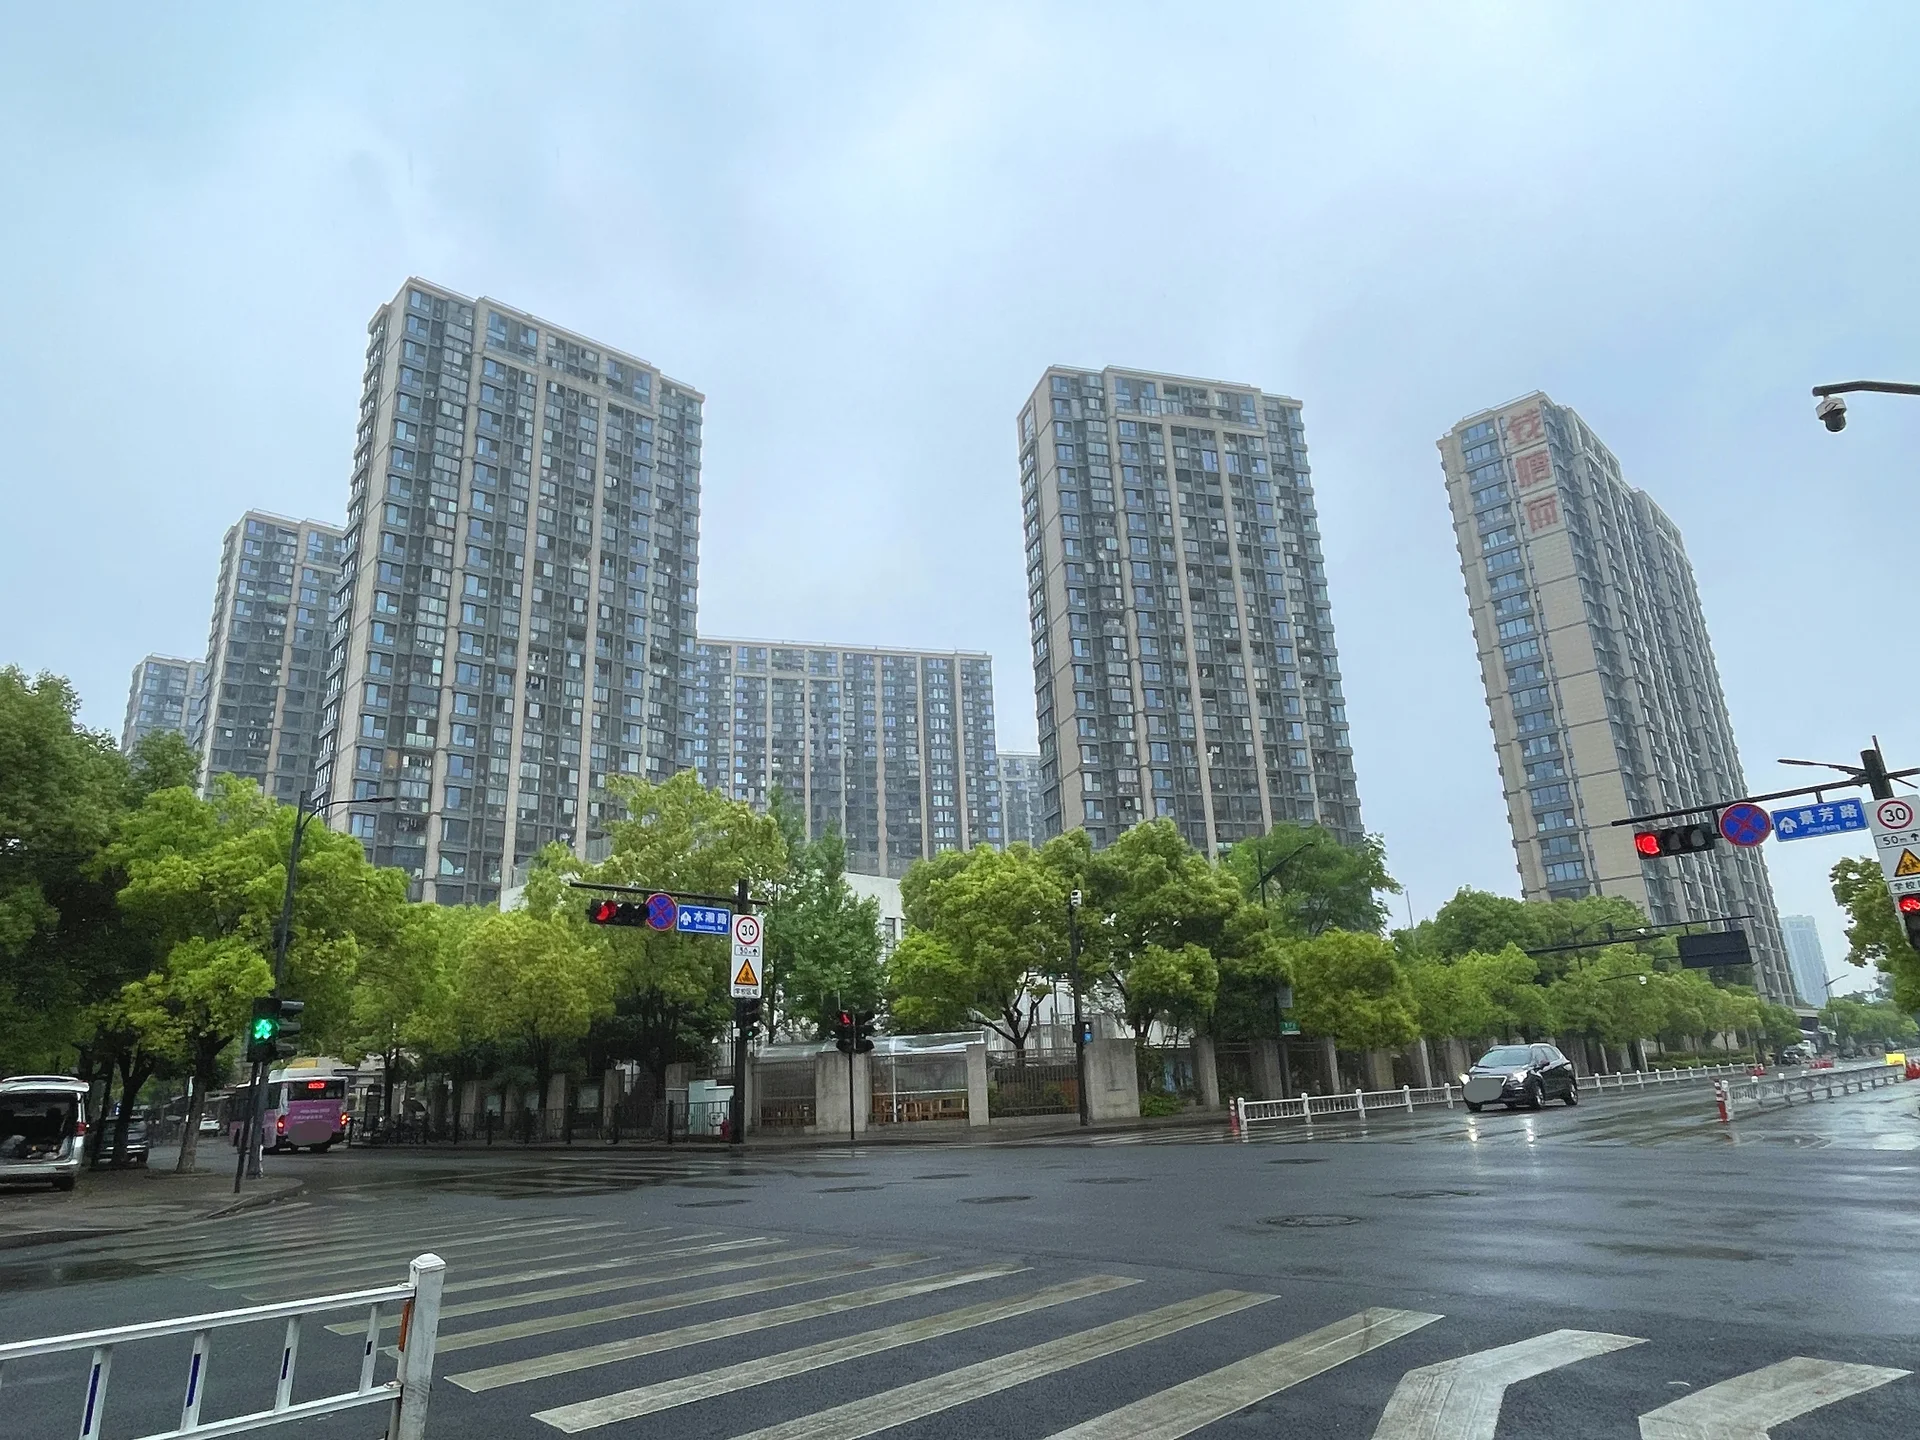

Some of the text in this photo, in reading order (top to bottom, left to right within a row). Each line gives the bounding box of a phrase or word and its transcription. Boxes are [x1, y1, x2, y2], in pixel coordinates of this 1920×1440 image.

[1799, 804, 1857, 825] 景芳路
[1884, 808, 1906, 822] 30
[1883, 835, 1908, 846] 50m
[741, 925, 755, 936] 30
